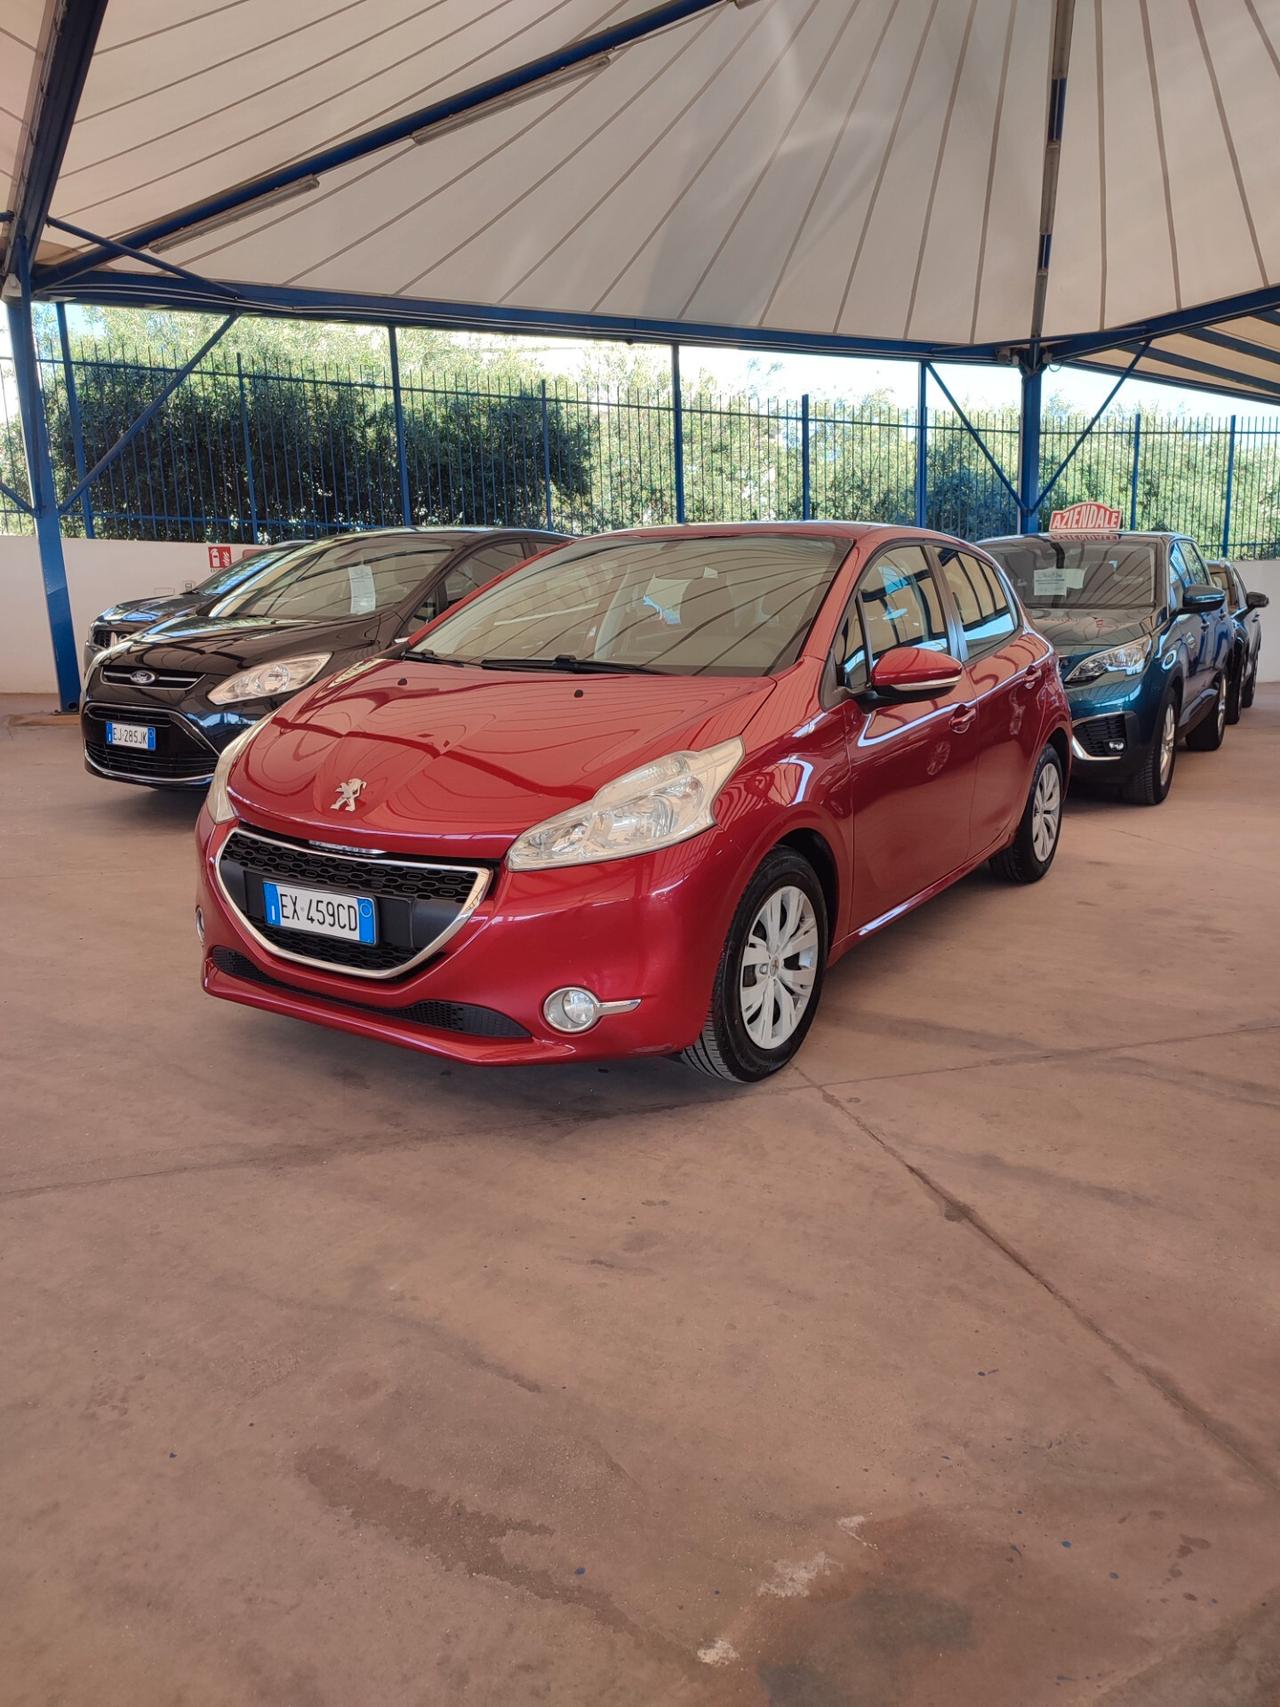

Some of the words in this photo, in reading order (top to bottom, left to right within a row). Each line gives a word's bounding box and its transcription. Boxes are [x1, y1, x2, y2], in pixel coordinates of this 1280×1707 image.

[1052, 504, 1118, 529] AZIENDALE
[280, 893, 300, 921] EX
[306, 898, 358, 932] 459CD
